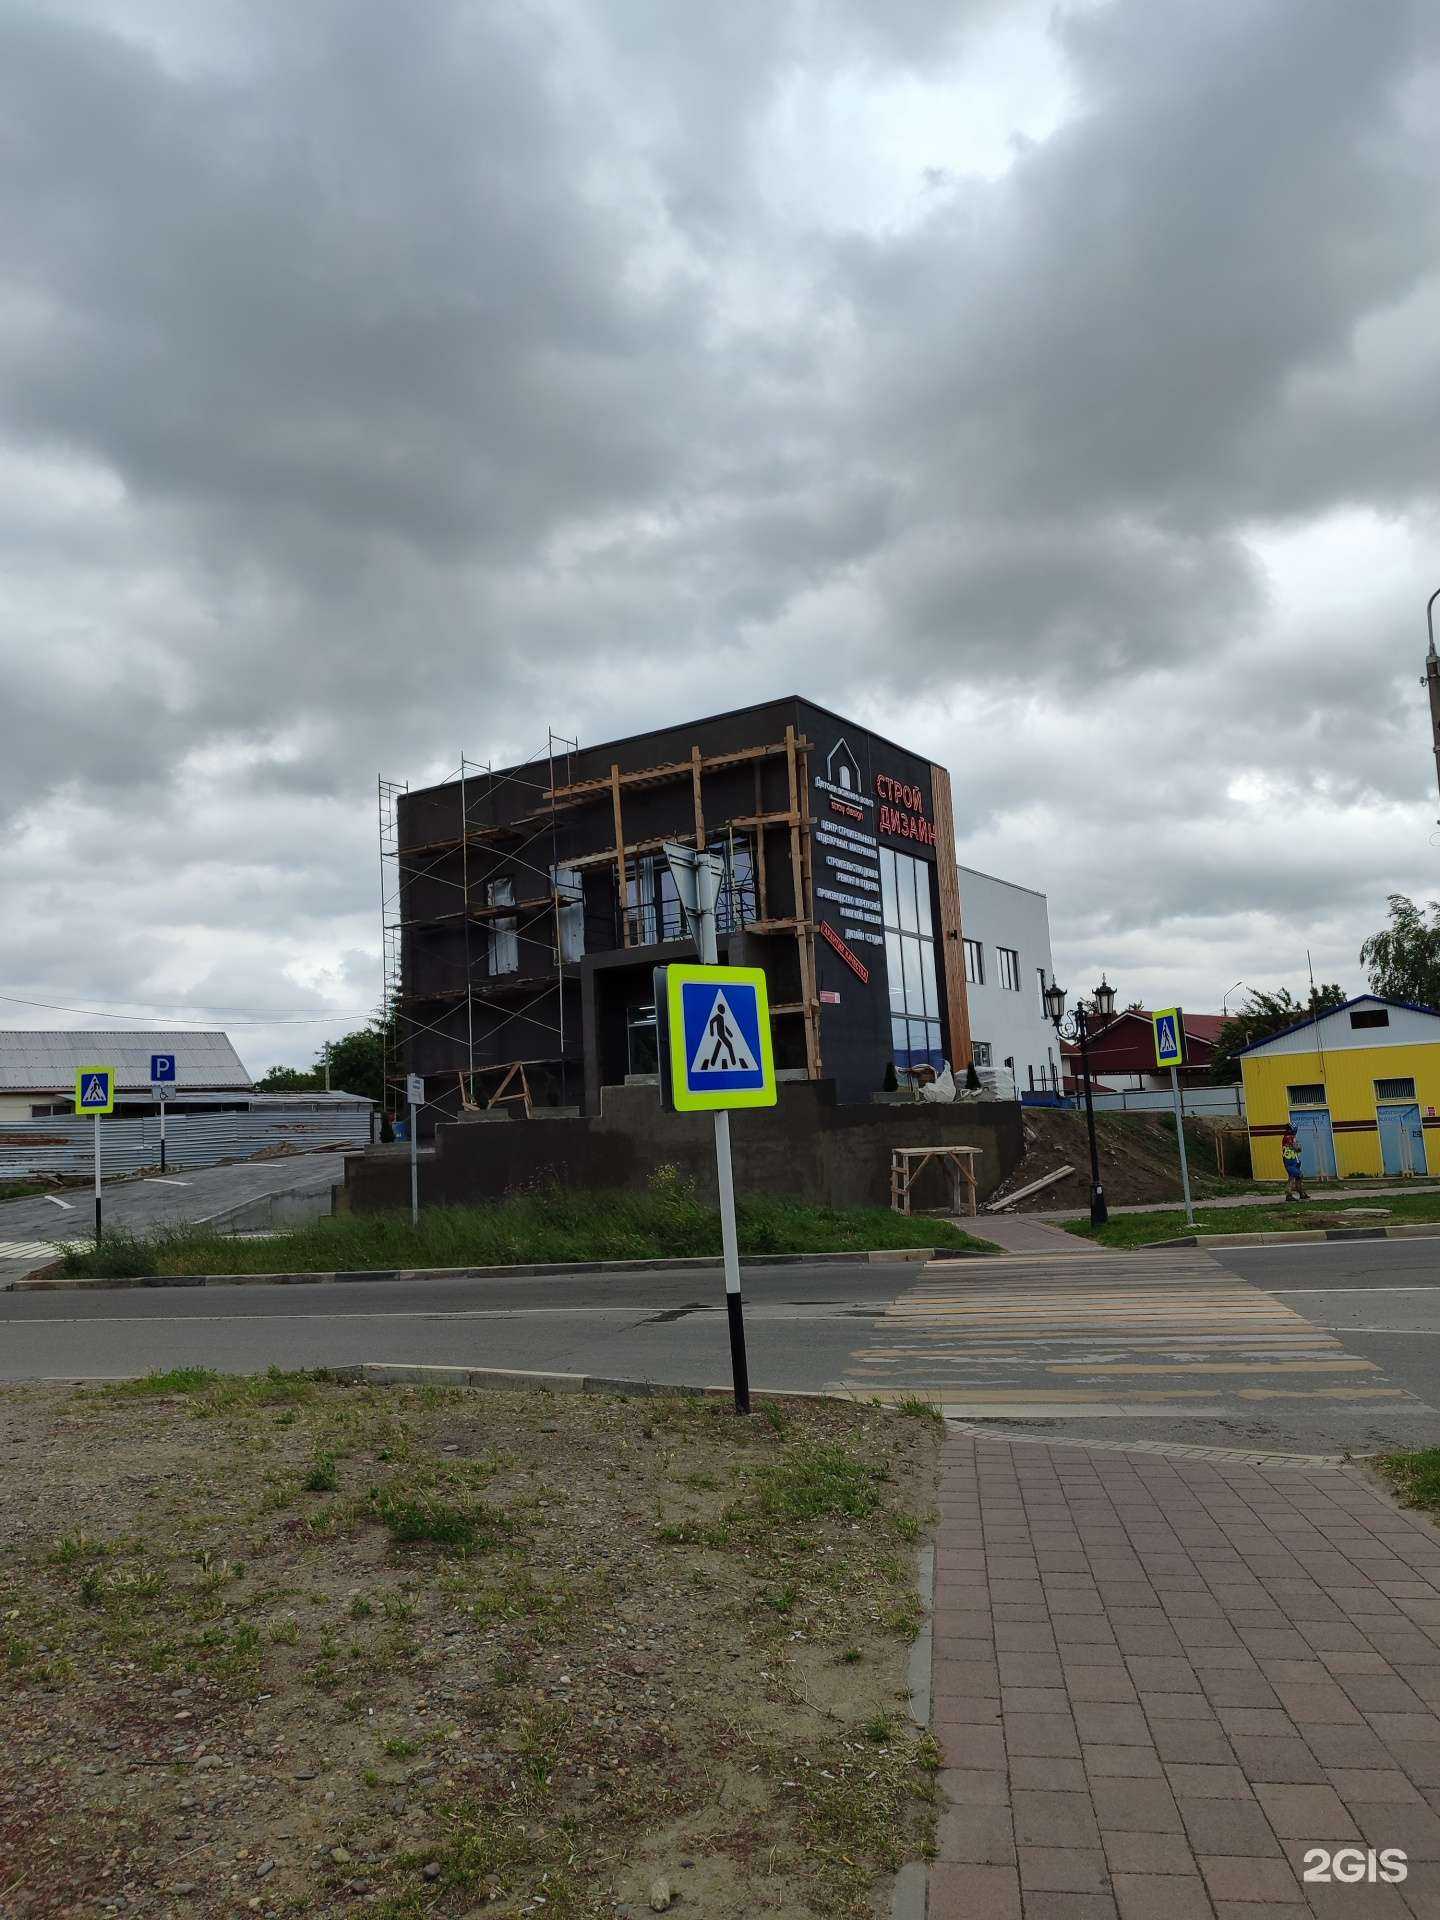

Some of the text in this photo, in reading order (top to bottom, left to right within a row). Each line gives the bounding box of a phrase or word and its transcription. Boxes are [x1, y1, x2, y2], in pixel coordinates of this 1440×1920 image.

[877, 774, 922, 813] СТРОЙ
[880, 805, 937, 845] ДИЗАЙН
[156, 1058, 170, 1078] P
